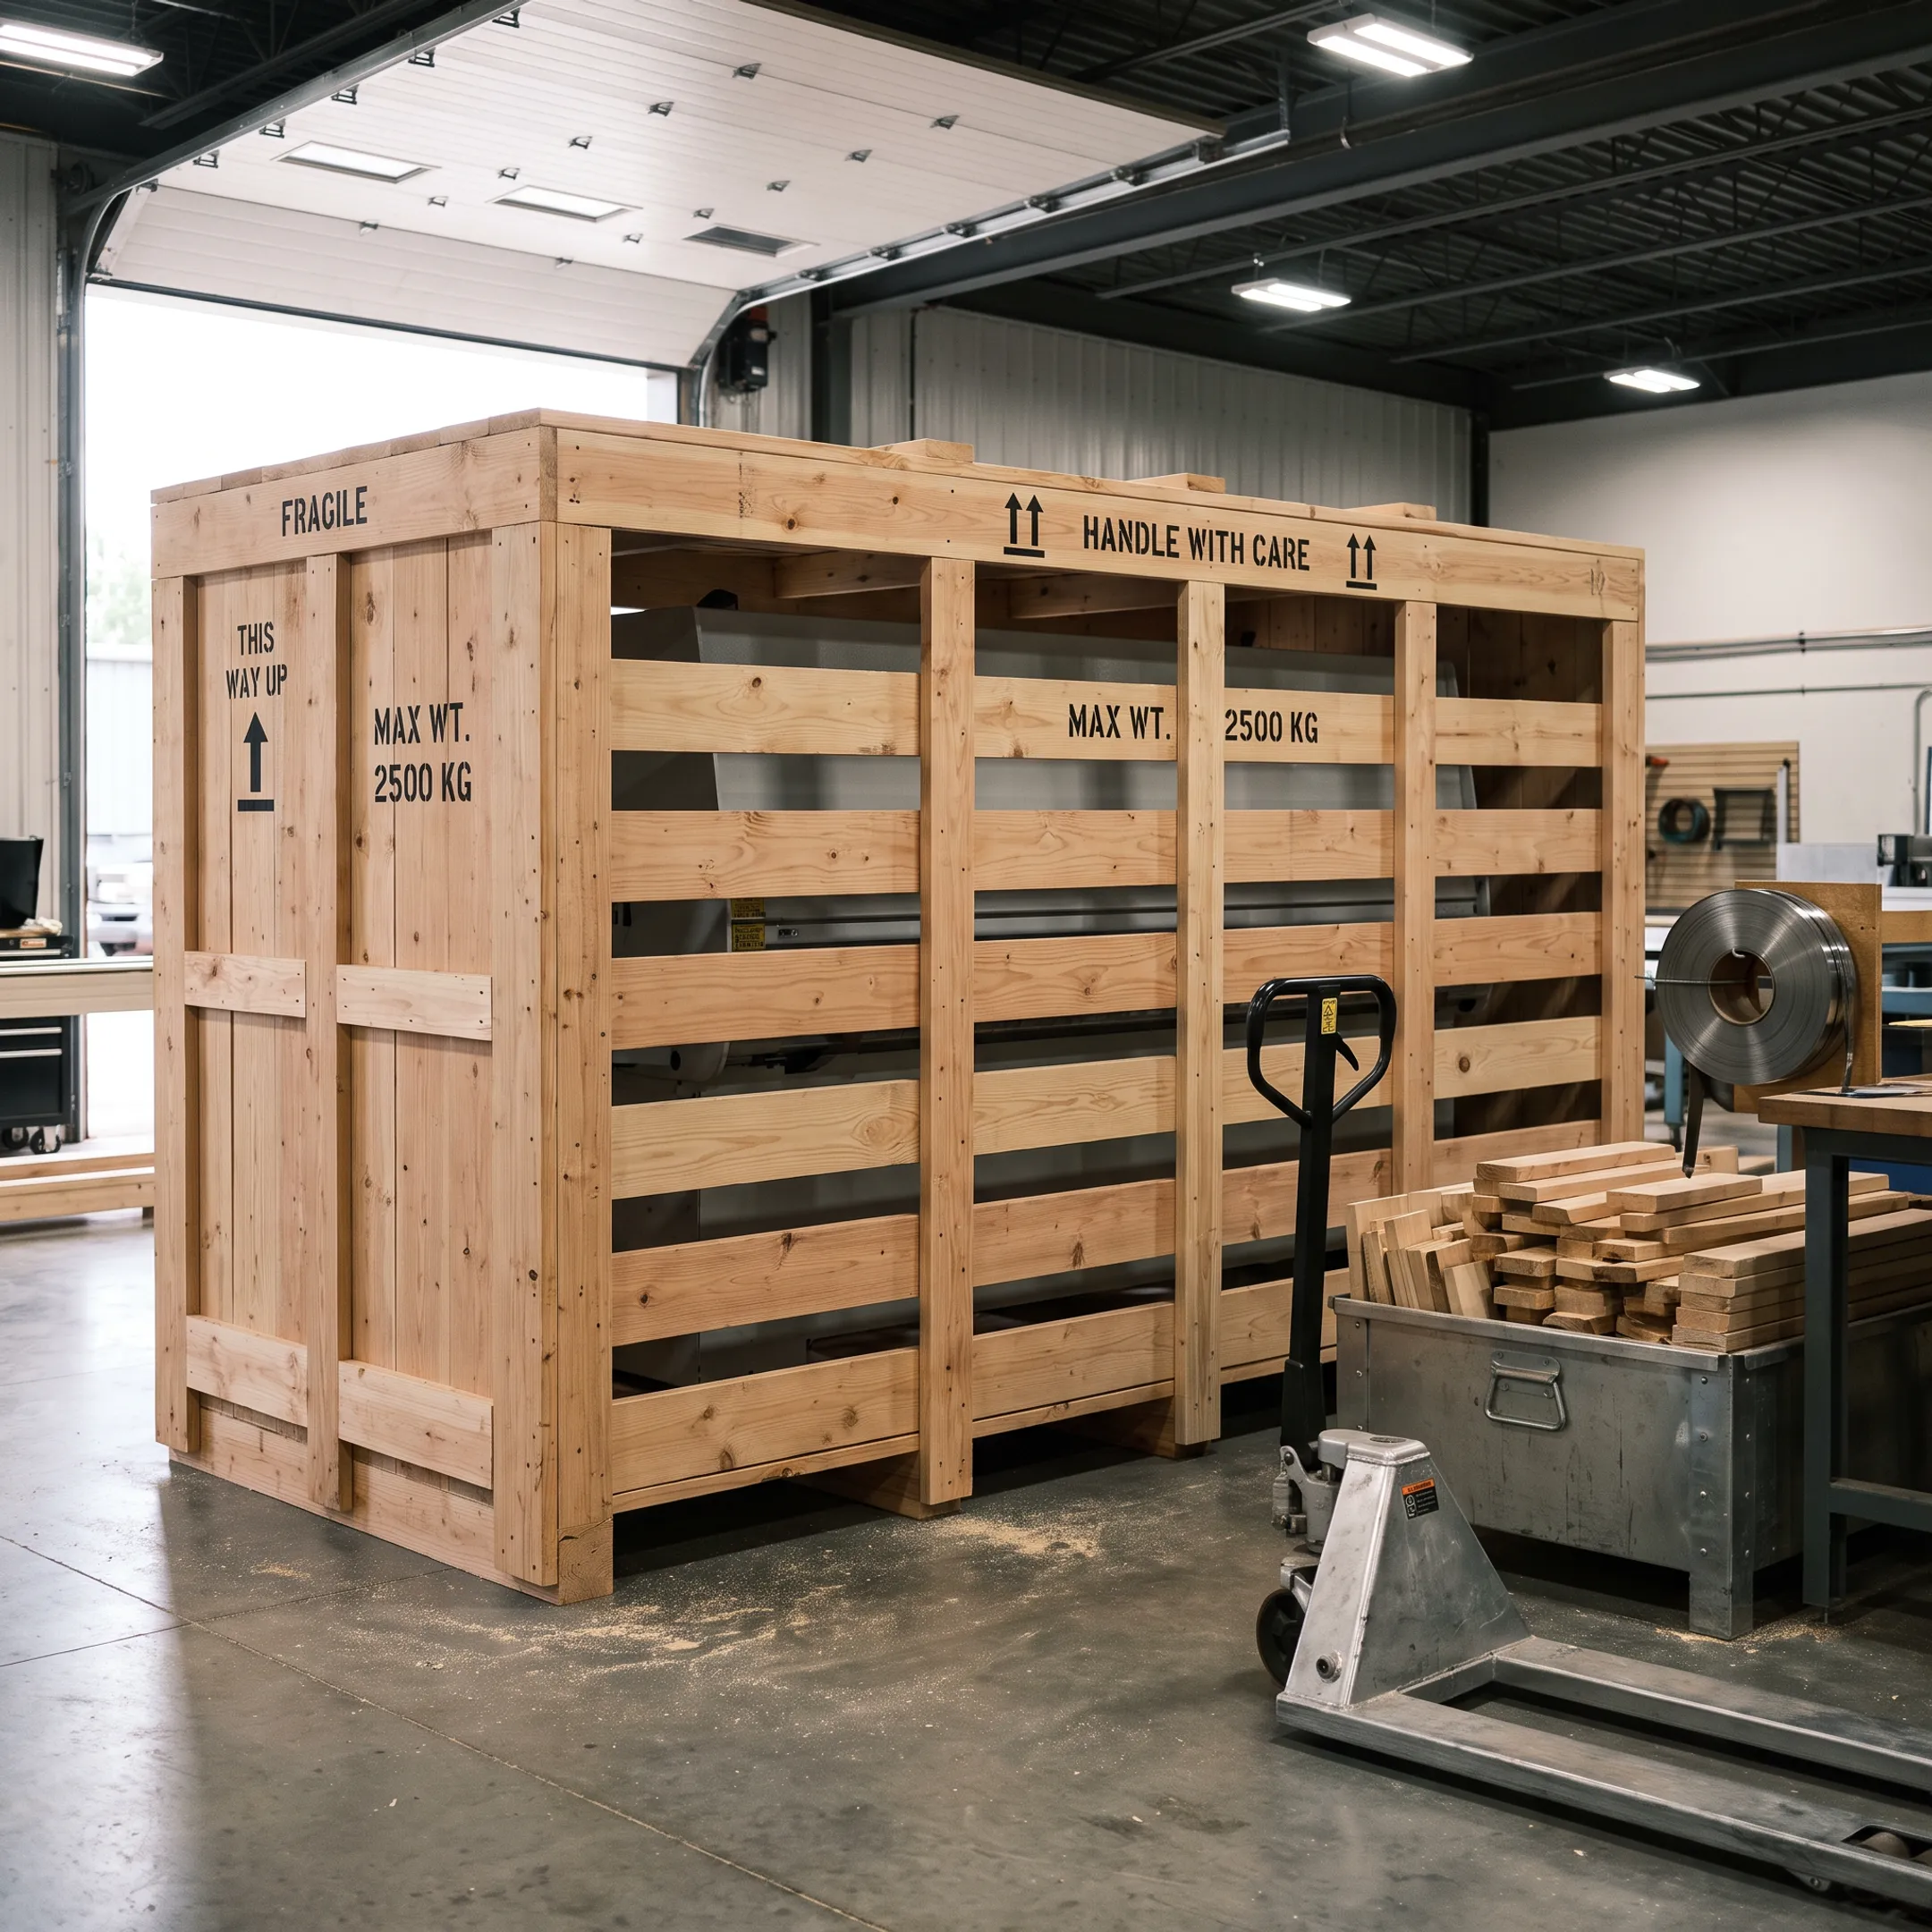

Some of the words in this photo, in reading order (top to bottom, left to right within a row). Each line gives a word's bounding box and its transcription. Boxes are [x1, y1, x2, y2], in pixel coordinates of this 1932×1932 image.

[282, 486, 369, 537] FRAGILE
[1083, 514, 1180, 559] HANDLE
[1187, 527, 1245, 564] WITH
[1252, 534, 1310, 571] CARE
[237, 621, 275, 656] THIS
[225, 666, 260, 699] WAY
[266, 664, 288, 696] UP
[374, 705, 421, 745] MAX
[428, 701, 470, 743] WT.
[1069, 703, 1121, 739] MAX
[1129, 706, 1172, 741] WT.
[1224, 708, 1283, 742] 2500
[1291, 711, 1318, 744] KG
[374, 762, 434, 803] 2500
[441, 761, 472, 802] KG
